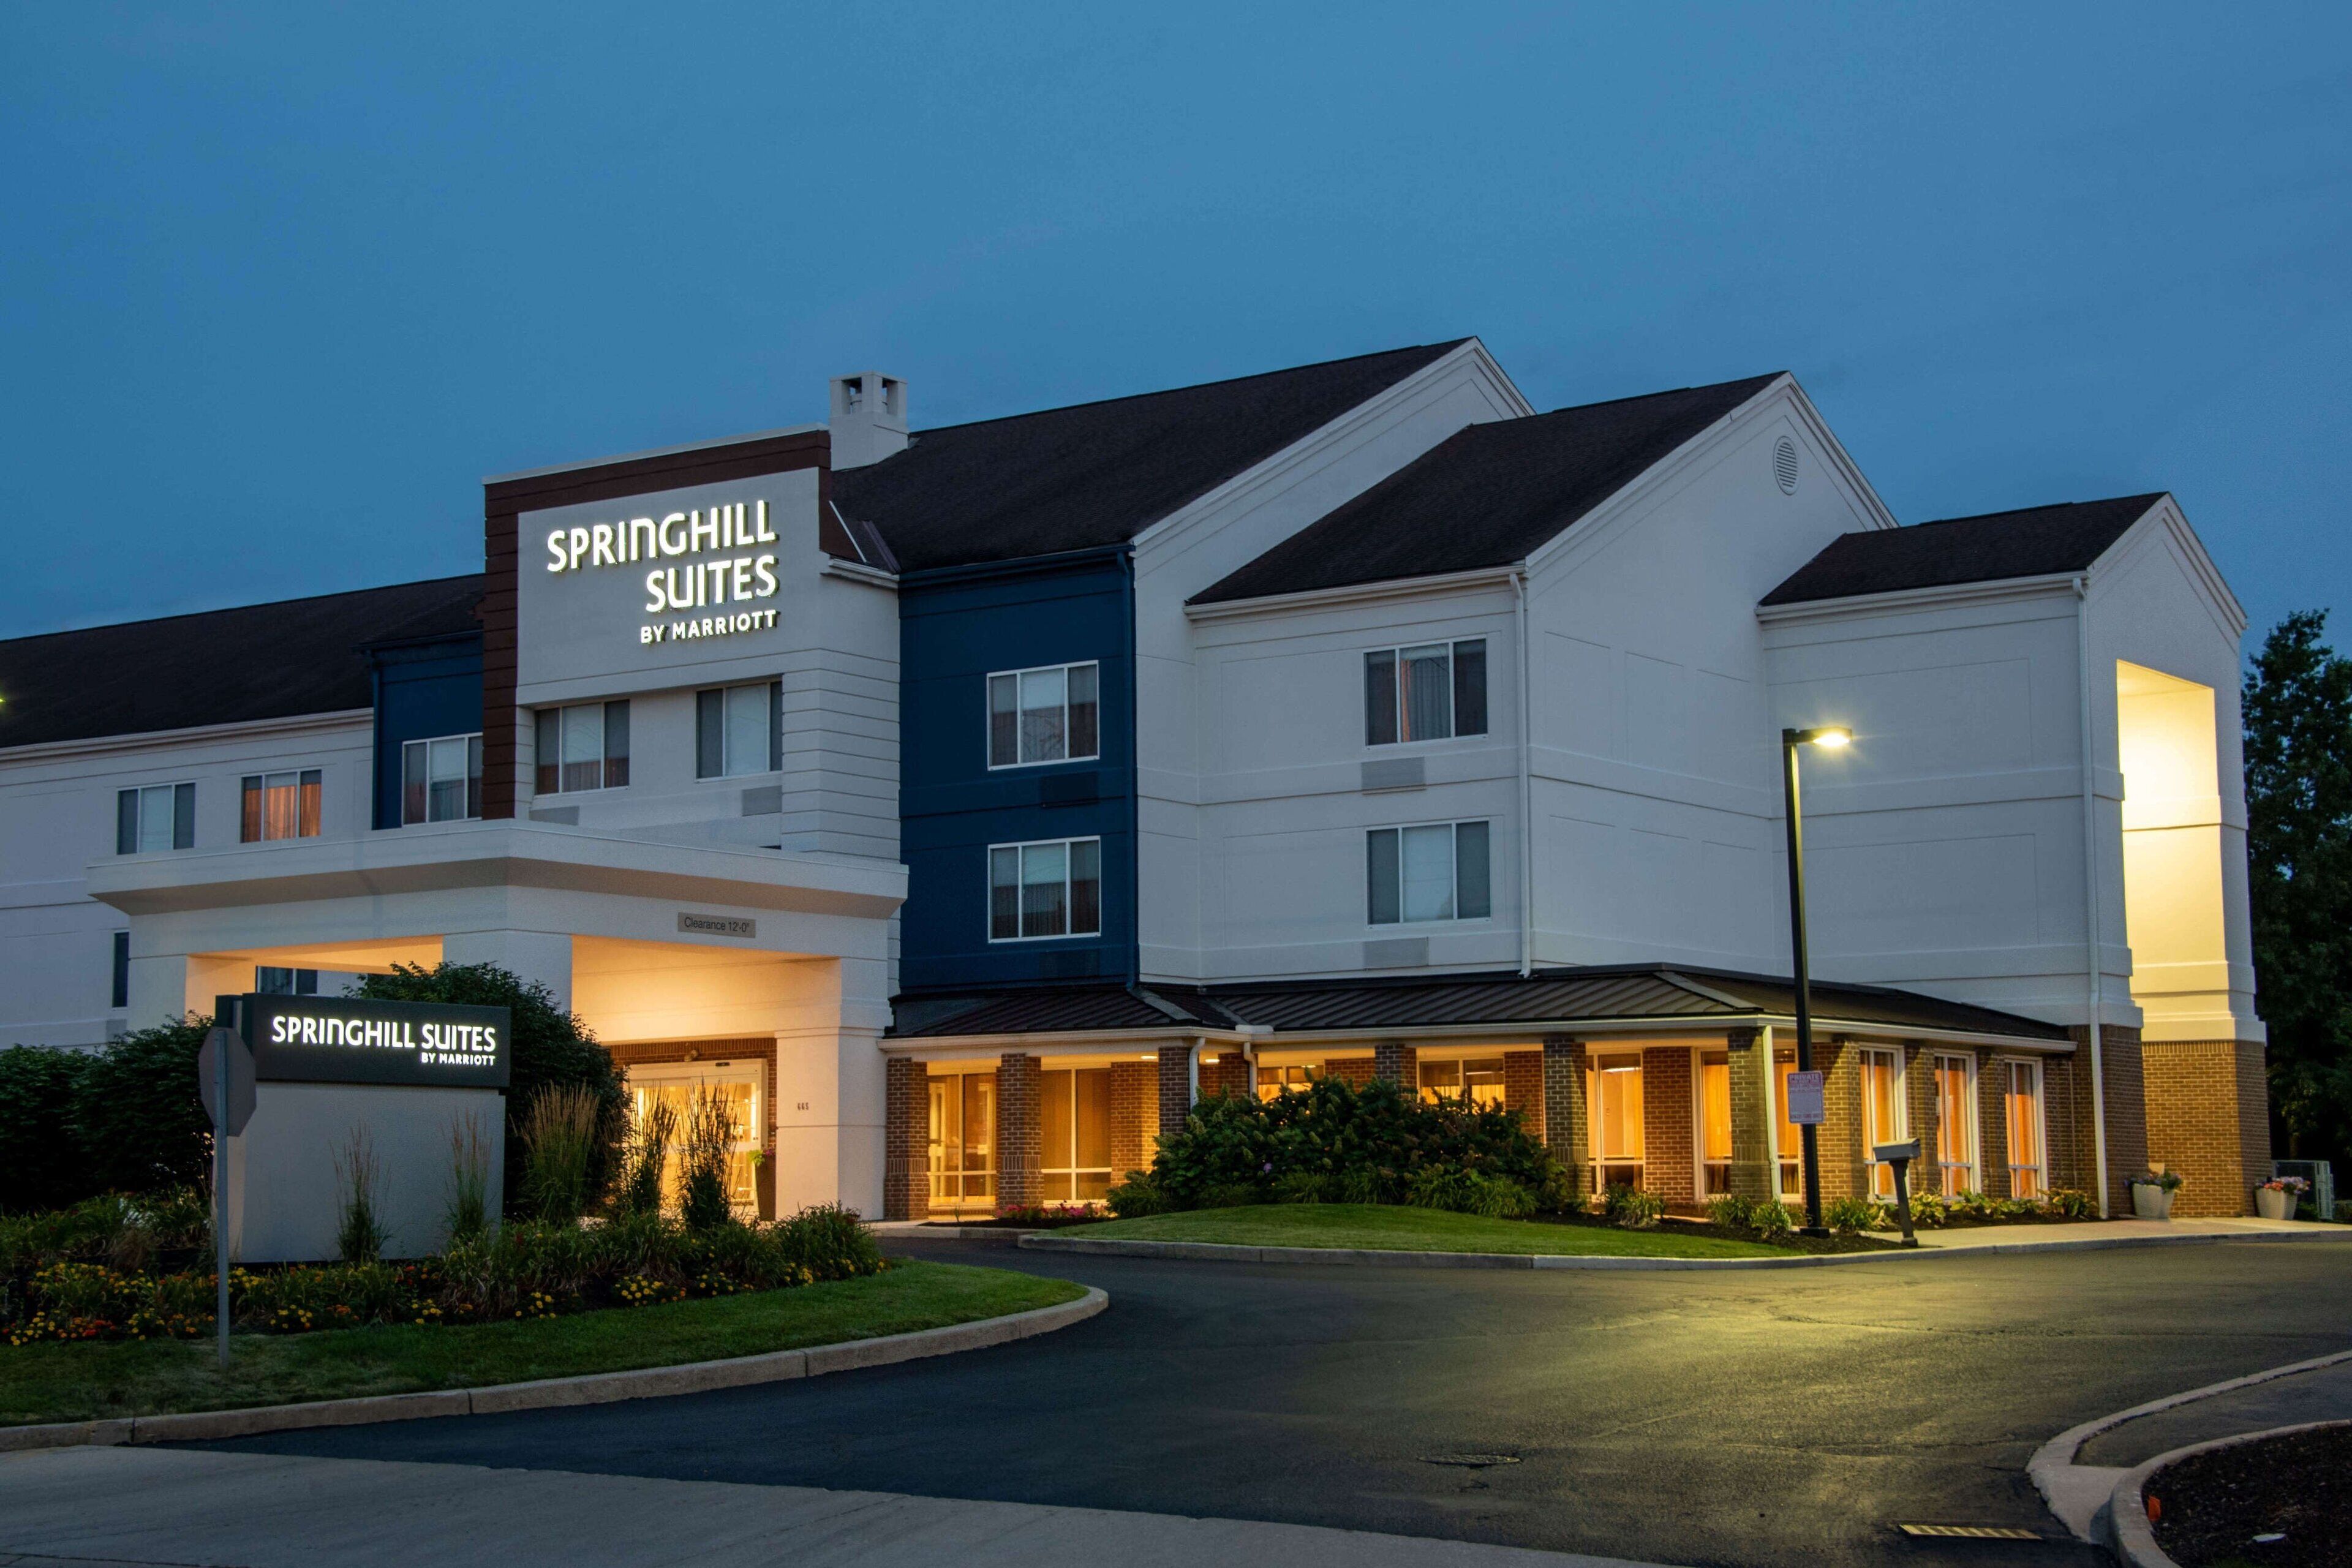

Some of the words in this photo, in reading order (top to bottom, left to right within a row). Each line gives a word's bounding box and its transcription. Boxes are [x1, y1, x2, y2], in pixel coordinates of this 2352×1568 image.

[547, 499, 778, 573] SPRINGHILL
[645, 554, 778, 613] SUITES
[640, 625, 667, 644] BY
[672, 609, 778, 640] MARRIOTT
[684, 917, 726, 930] Clearance
[272, 1016, 415, 1048] SPRINGHILL
[421, 1023, 496, 1052] SUITES
[421, 1052, 436, 1064] BY
[439, 1053, 496, 1066] MARRIOTT
